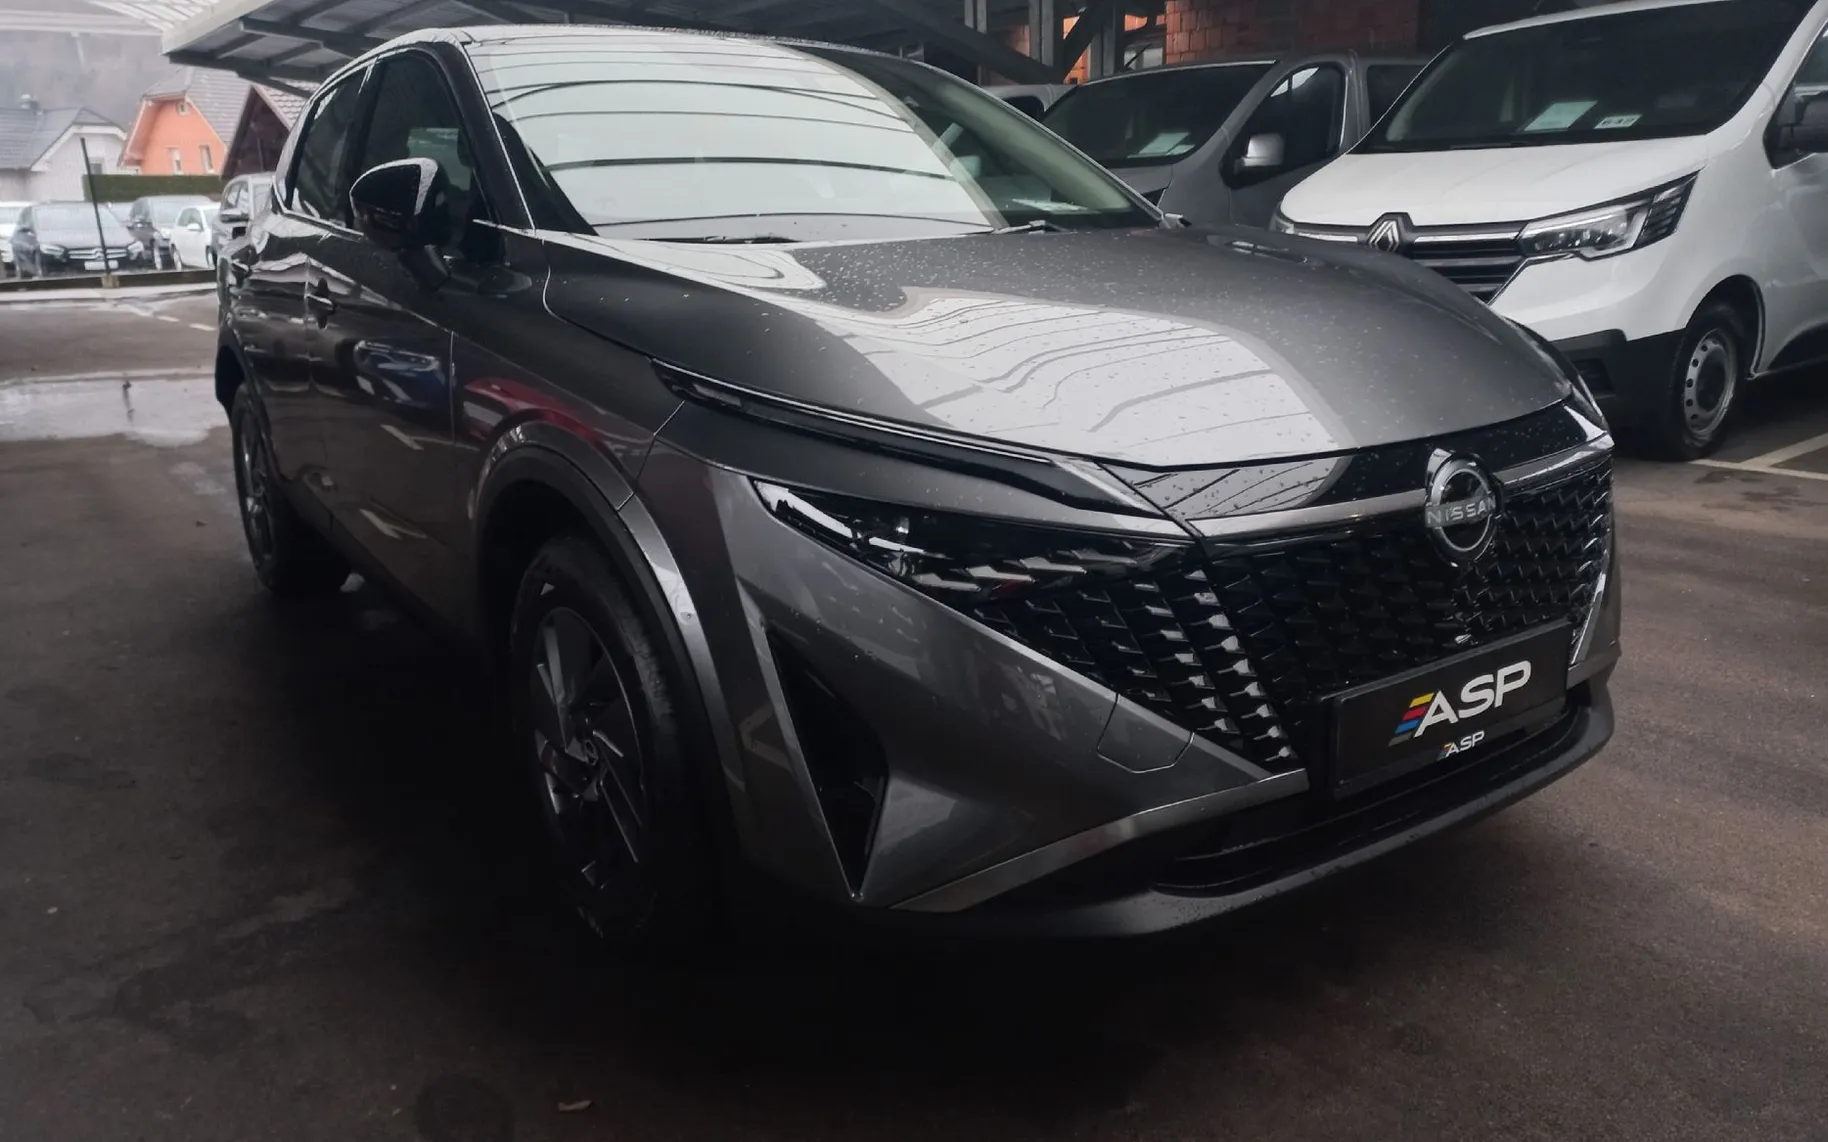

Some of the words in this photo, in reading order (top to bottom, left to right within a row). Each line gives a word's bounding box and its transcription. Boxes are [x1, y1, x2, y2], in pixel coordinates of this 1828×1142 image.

[1427, 495, 1496, 524] NISSAN
[1414, 660, 1531, 737] ASP
[1446, 731, 1485, 757] ASP
